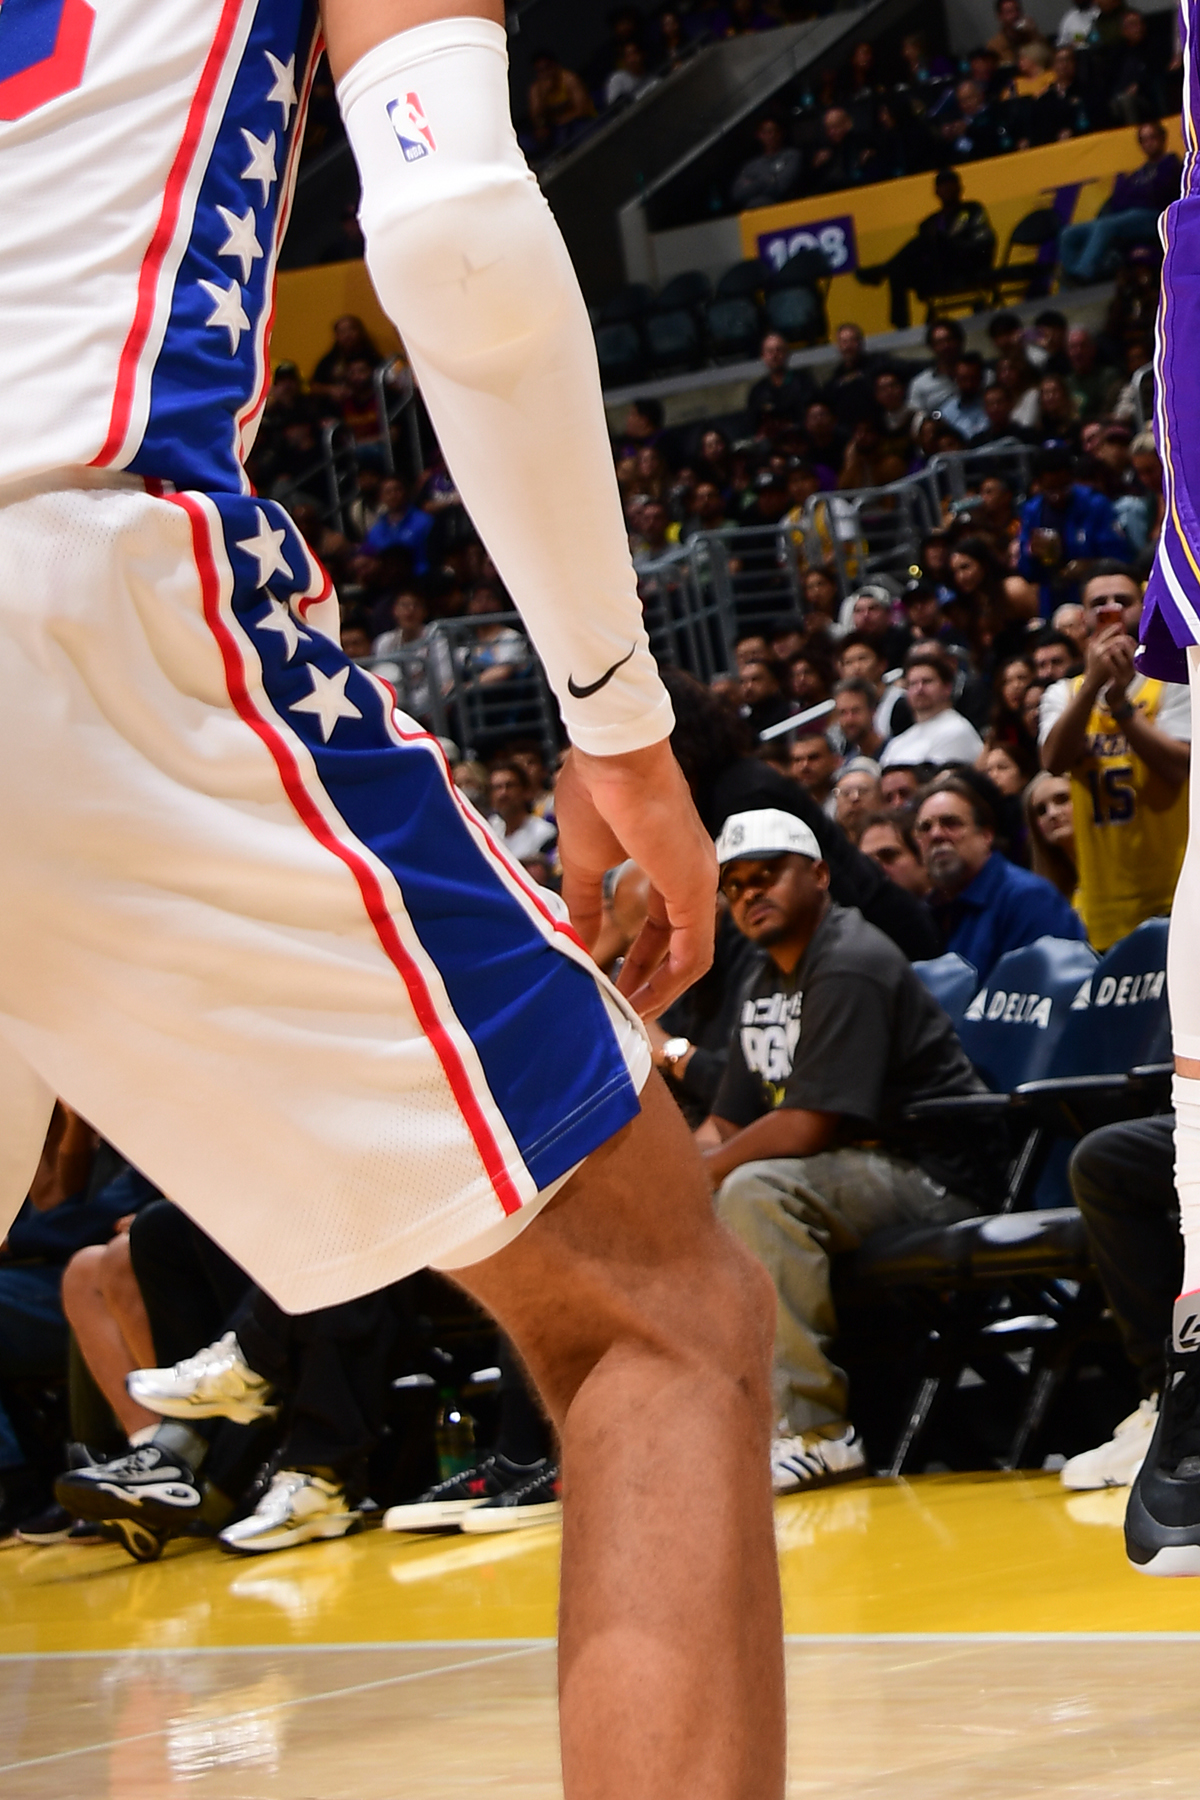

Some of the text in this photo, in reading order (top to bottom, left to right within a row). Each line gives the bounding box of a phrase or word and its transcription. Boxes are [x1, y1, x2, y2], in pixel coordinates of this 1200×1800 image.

[406, 144, 425, 161] NBA
[1087, 765, 1137, 826] 15
[1095, 970, 1166, 1008] DELTA
[986, 990, 1053, 1029] DELTA
